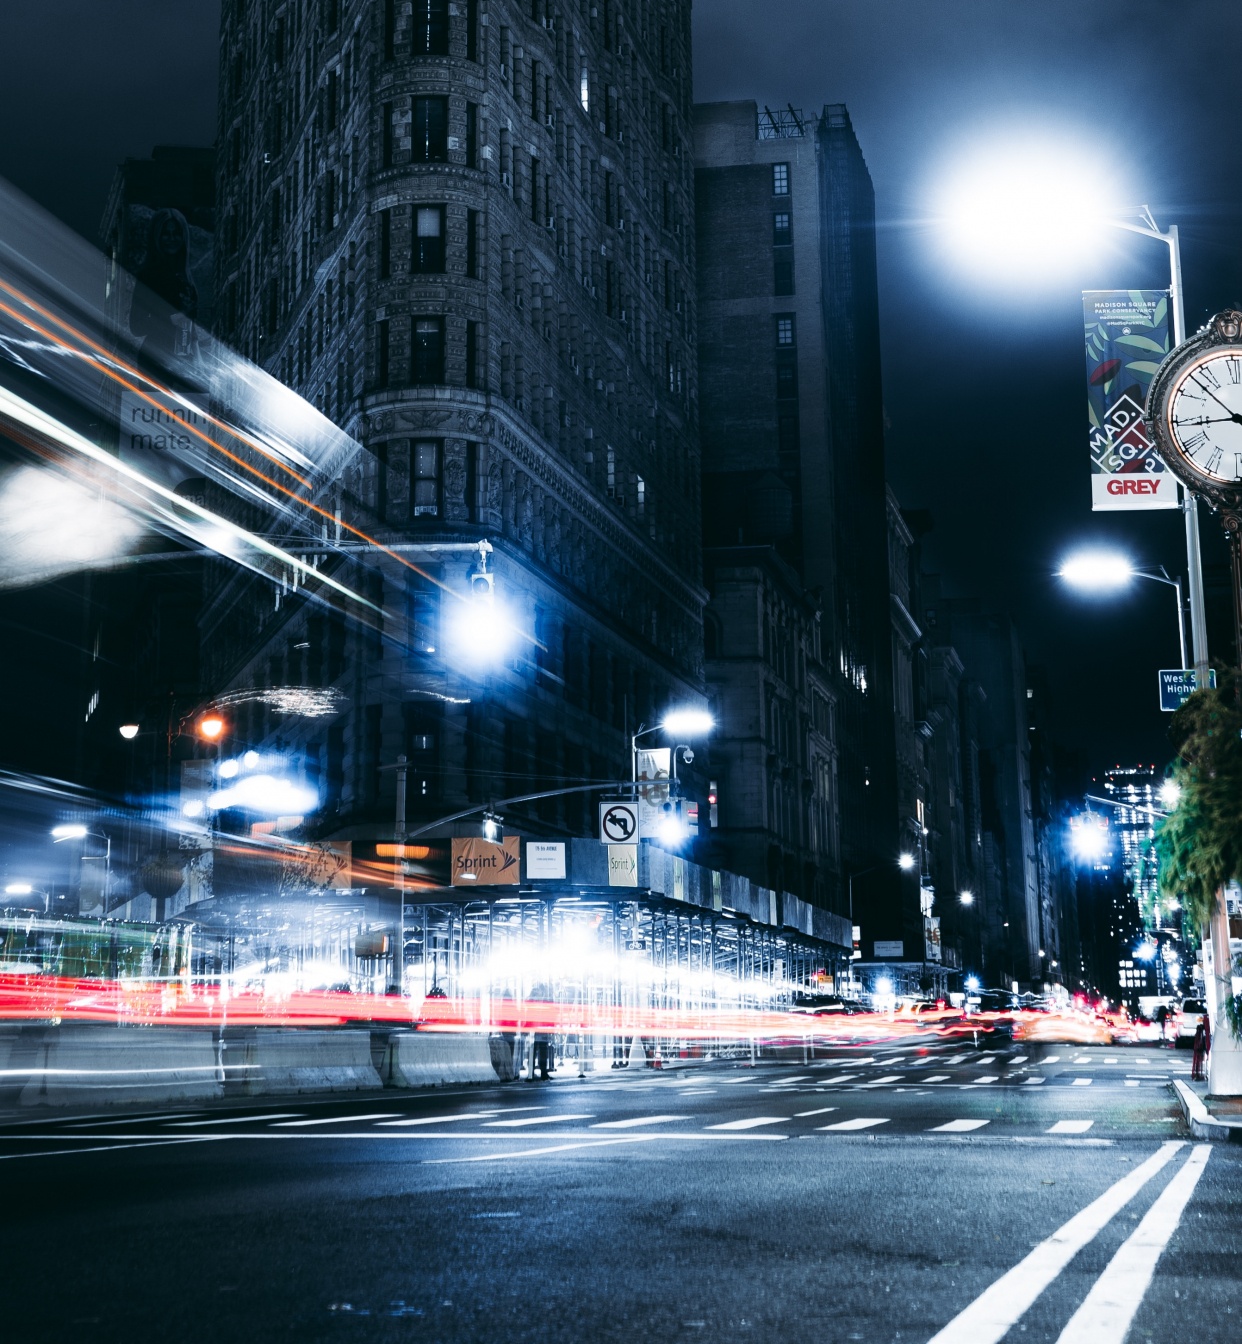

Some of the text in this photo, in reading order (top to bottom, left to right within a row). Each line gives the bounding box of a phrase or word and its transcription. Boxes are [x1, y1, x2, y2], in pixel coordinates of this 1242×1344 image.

[1106, 479, 1161, 495] GREY
[1163, 674, 1187, 683] Wes
[456, 854, 497, 872] Sprint
[610, 857, 629, 872] Sprint
